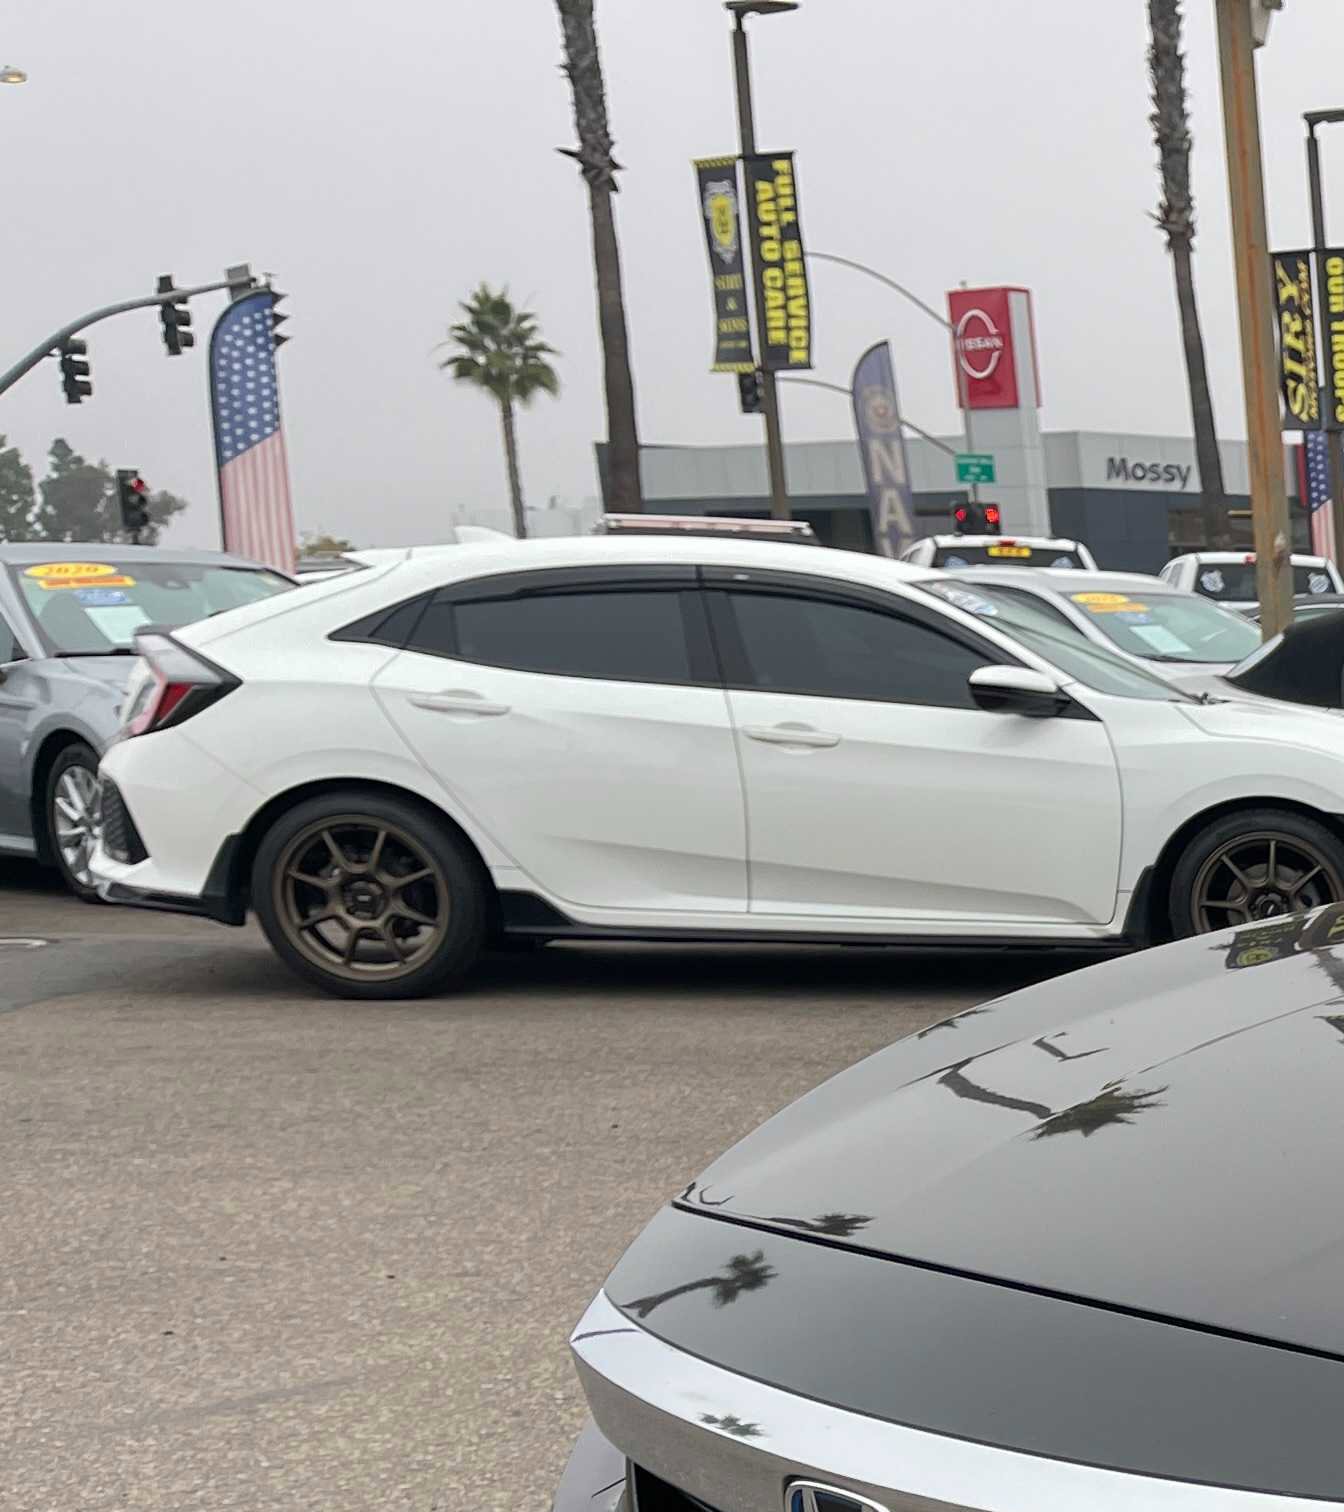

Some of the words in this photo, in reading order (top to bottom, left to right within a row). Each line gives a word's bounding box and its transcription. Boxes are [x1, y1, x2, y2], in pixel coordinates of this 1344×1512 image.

[754, 179, 782, 262] AUTO
[771, 158, 798, 225] FULL
[762, 266, 788, 346] CARE
[783, 239, 810, 364] SERVICE
[1106, 457, 1191, 490] Mossy
